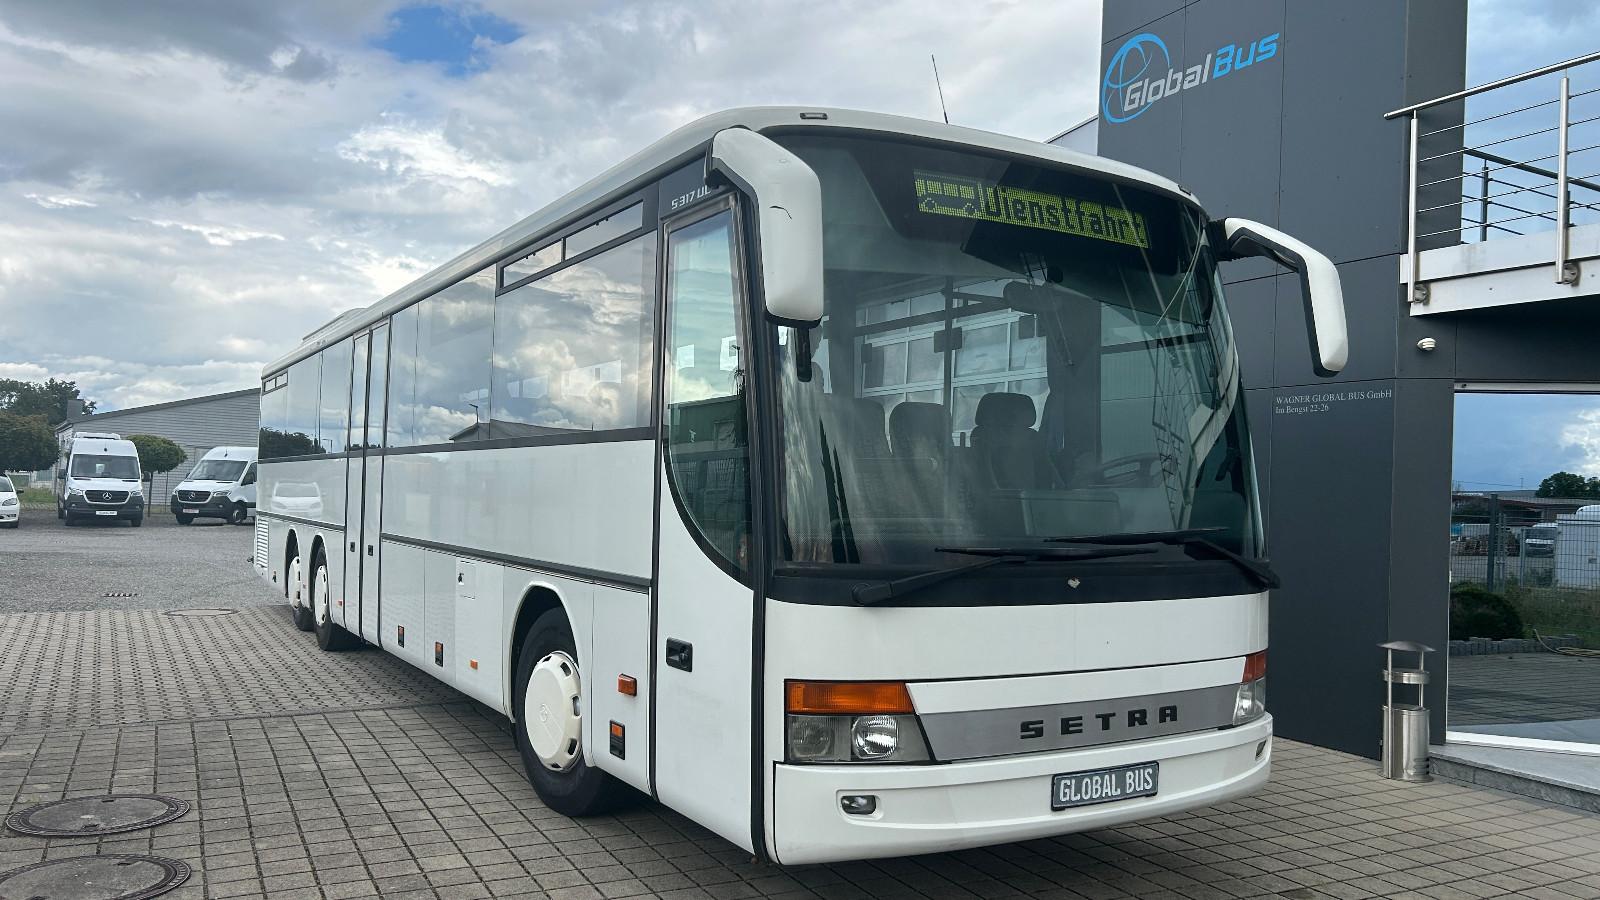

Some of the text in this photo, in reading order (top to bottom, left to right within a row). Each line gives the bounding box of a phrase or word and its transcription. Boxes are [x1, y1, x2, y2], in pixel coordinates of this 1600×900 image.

[983, 184, 1146, 244] Dienstfahrt
[1275, 403, 1329, 415] Im Bengst 22-26
[1276, 389, 1393, 404] WAGNER GLOBAL BUS GmbH
[1020, 705, 1178, 740] SETRA
[1059, 767, 1153, 802] GLOBAL BUS
